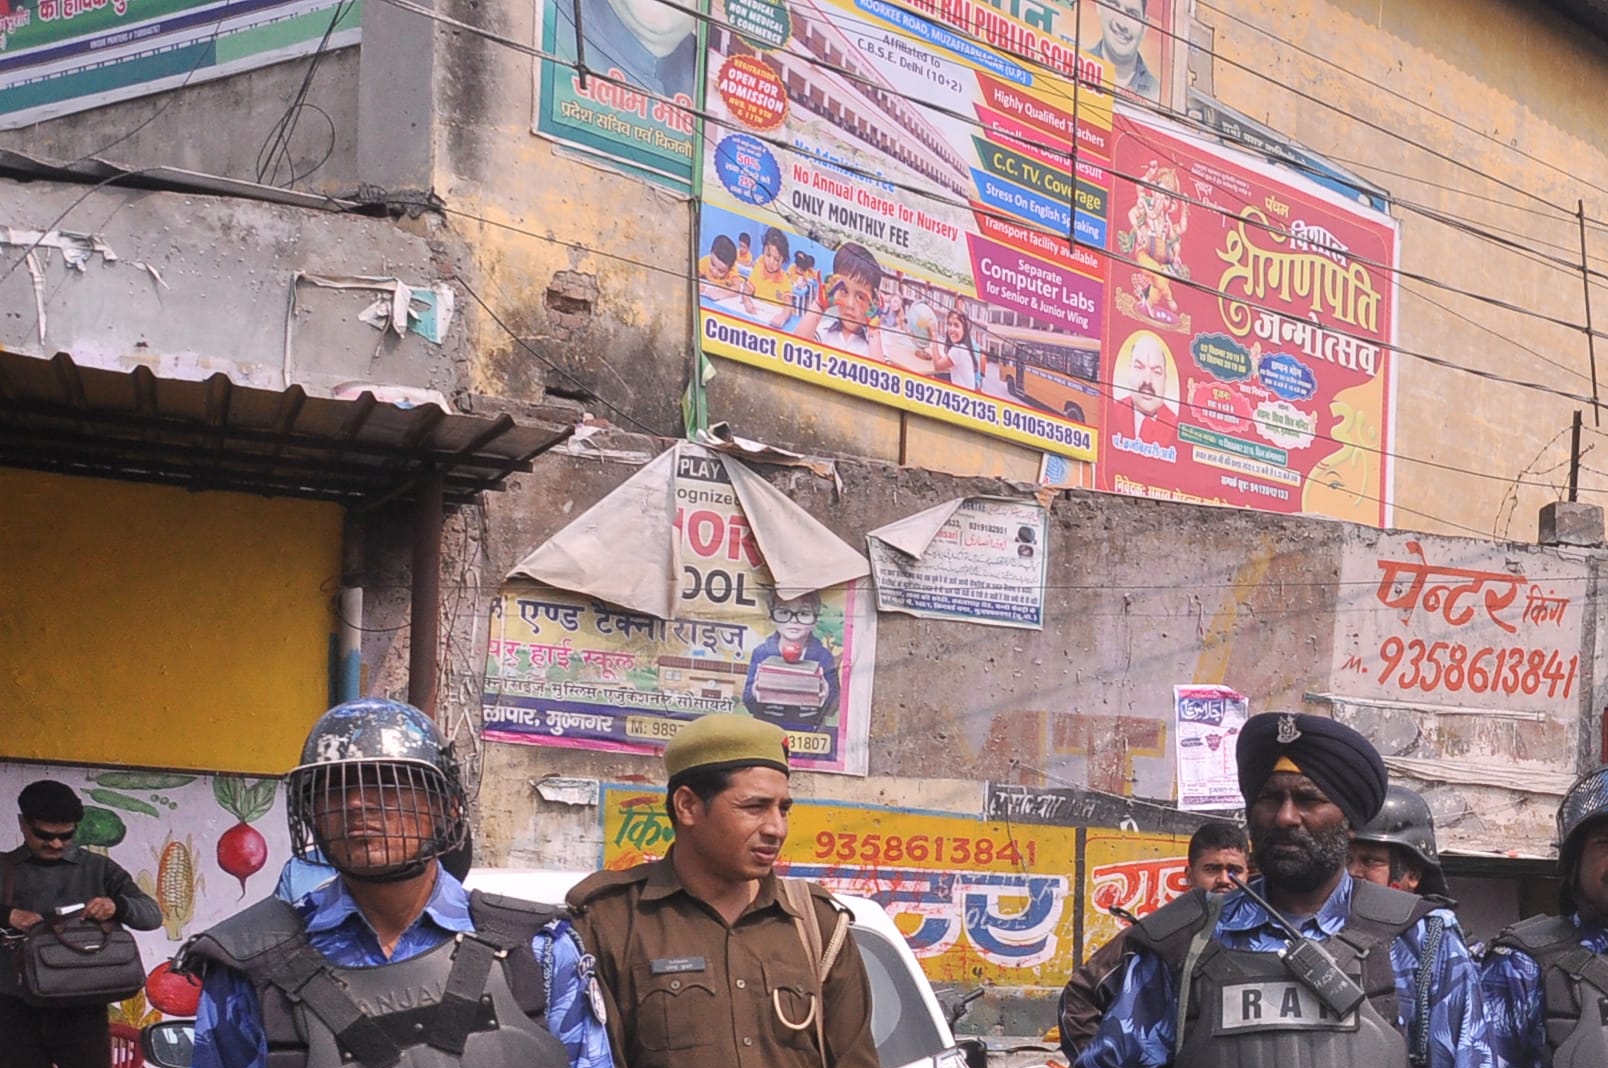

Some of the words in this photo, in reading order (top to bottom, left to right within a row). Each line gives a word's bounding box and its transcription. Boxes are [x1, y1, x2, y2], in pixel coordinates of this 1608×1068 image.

[729, 3, 748, 17] NON
[748, 9, 784, 33] MEDICAL
[737, 18, 783, 44] COMMERCE
[857, 38, 896, 65] C.B.S.E.
[900, 53, 923, 76] Delhi
[927, 69, 963, 93] (10+2)
[883, 34, 926, 63] Affiliated
[928, 54, 941, 68] to
[903, 15, 930, 37] ROAD,
[931, 28, 1004, 70] MUZAFFARNAGAR
[1005, 60, 1026, 83] (U.P.)
[975, 12, 1036, 62] PUBLIC
[1038, 38, 1105, 95] SCHOL
[720, 79, 784, 114] ADMISSION
[728, 68, 756, 88] OPEN
[758, 79, 778, 98] FOR
[561, 102, 593, 124] प्रदेश
[994, 88, 1023, 113] Highly
[1025, 103, 1066, 131] Qualified
[1068, 120, 1105, 147] Tachers
[993, 152, 1018, 176] C.C.
[1022, 164, 1041, 185] TV.
[1073, 157, 1103, 179] esult
[792, 190, 825, 218] ONLY
[828, 203, 886, 239] MONTHLY
[889, 225, 910, 248] FEE
[793, 164, 811, 184] No
[813, 172, 853, 202] Annual
[857, 189, 896, 217] Charge
[898, 203, 915, 222] for
[917, 210, 959, 242] Nursery
[985, 182, 1013, 203] Stress
[1015, 194, 1027, 209] On
[1030, 200, 1061, 223] English
[1062, 212, 1100, 240] Spaking
[984, 215, 1028, 243] Transport
[1030, 231, 1058, 255] facility
[980, 258, 1060, 300] Computer
[1062, 286, 1096, 314] Labs
[1018, 259, 1063, 286] Separate
[986, 280, 1000, 295] for
[1001, 286, 1030, 307] Senior
[1030, 296, 1038, 310] &
[1040, 300, 1066, 319] Junior
[1067, 308, 1089, 329] Wing
[705, 317, 777, 358] Contact
[783, 342, 900, 395] 0131-2440938
[903, 379, 1000, 426] 9927452135,
[1002, 408, 1091, 451] 9410535894
[680, 458, 721, 480] PLAY
[675, 487, 741, 506] ognize
[1377, 541, 1529, 634] पेन्टर
[1522, 583, 1570, 627] किंग
[518, 600, 585, 634] एण्ड
[528, 638, 574, 670] हाई
[582, 648, 637, 680] स्कूल
[1377, 636, 1579, 699] 9358613841
[551, 682, 598, 701] मुस्लिम
[630, 720, 648, 736] M:
[787, 736, 828, 751] 31807
[814, 829, 1037, 866] 9358613841
